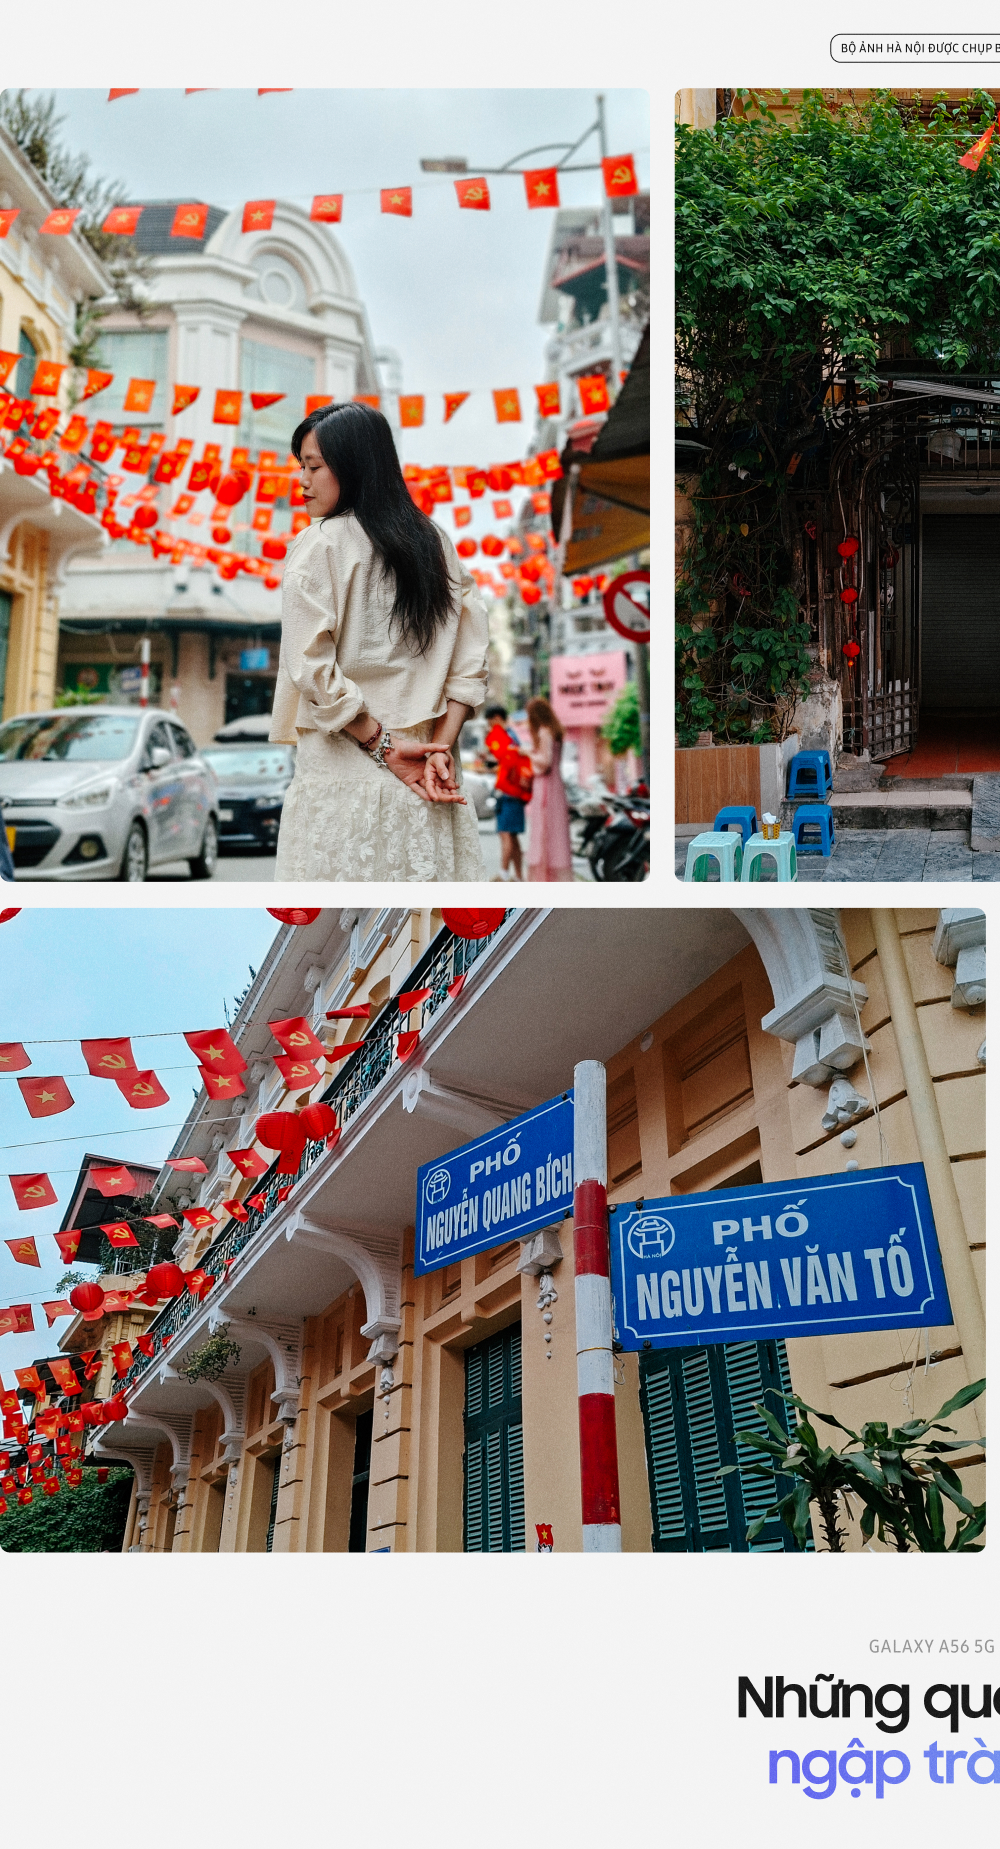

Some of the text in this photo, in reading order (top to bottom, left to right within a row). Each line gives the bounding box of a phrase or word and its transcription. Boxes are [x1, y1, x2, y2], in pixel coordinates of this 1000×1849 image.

[470, 1131, 522, 1183] PHỐ
[426, 1152, 573, 1252] NGUYỄN QUANG BÍCH
[712, 1198, 809, 1246] PHỐ
[636, 1227, 915, 1321] NGUYỄN VĂN TỐ
